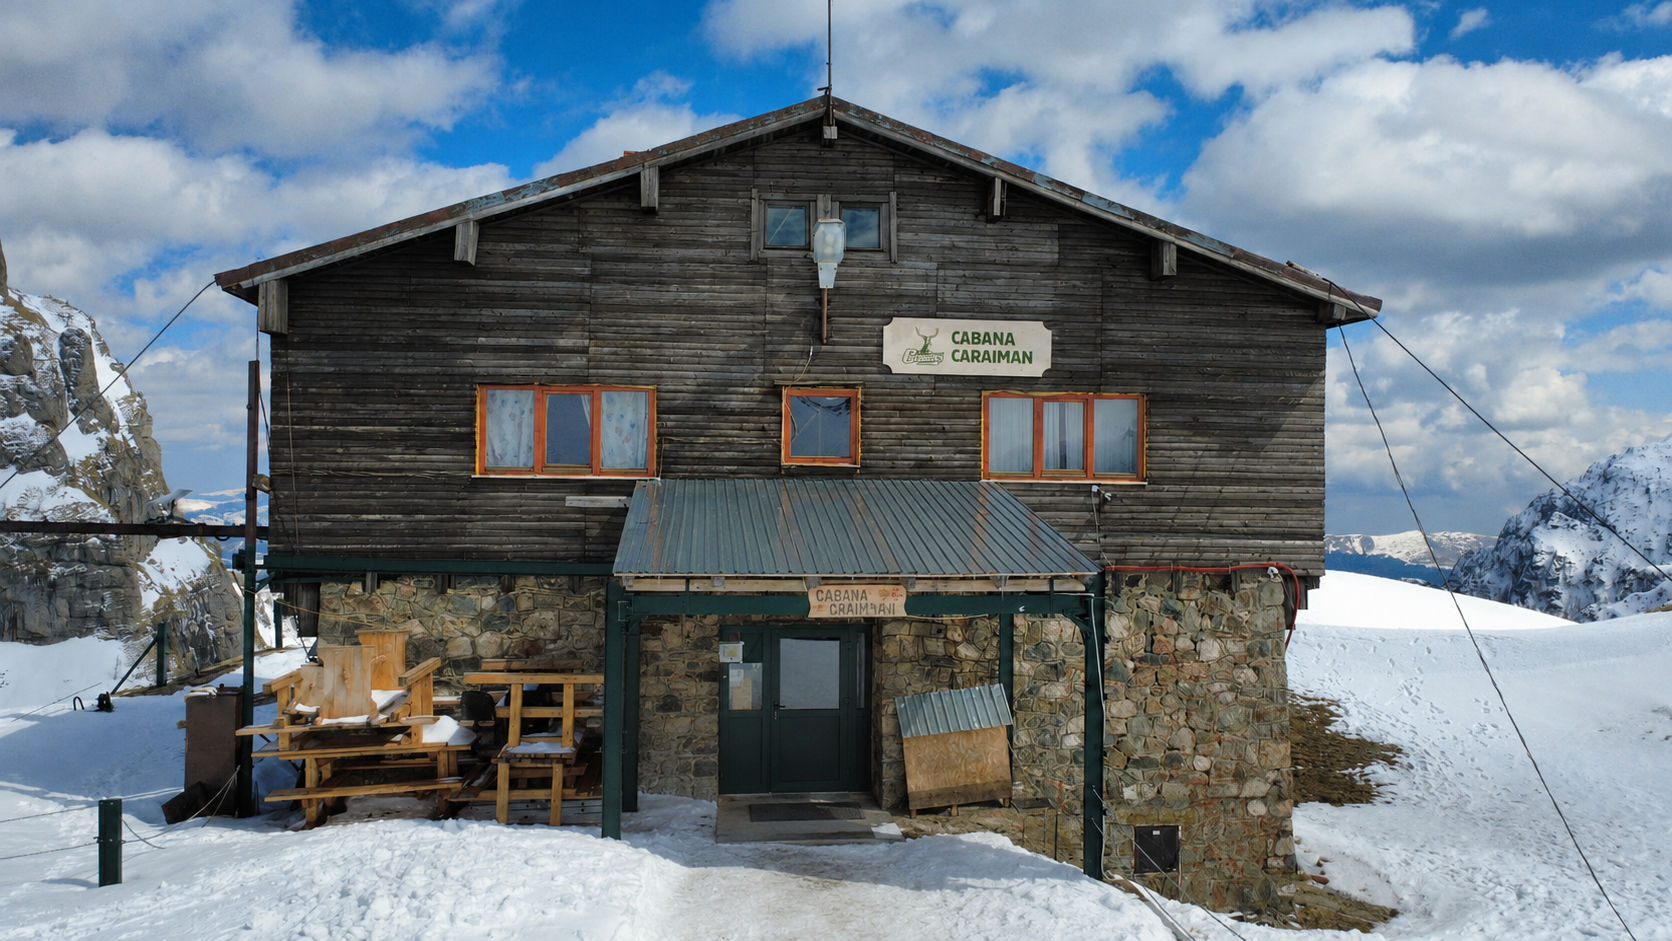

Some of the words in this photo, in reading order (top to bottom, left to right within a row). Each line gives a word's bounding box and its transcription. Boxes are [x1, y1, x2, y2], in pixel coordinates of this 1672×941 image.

[951, 331, 1016, 346] CABANA
[951, 349, 1033, 364] CARAIMAN
[815, 589, 868, 602] CABANA
